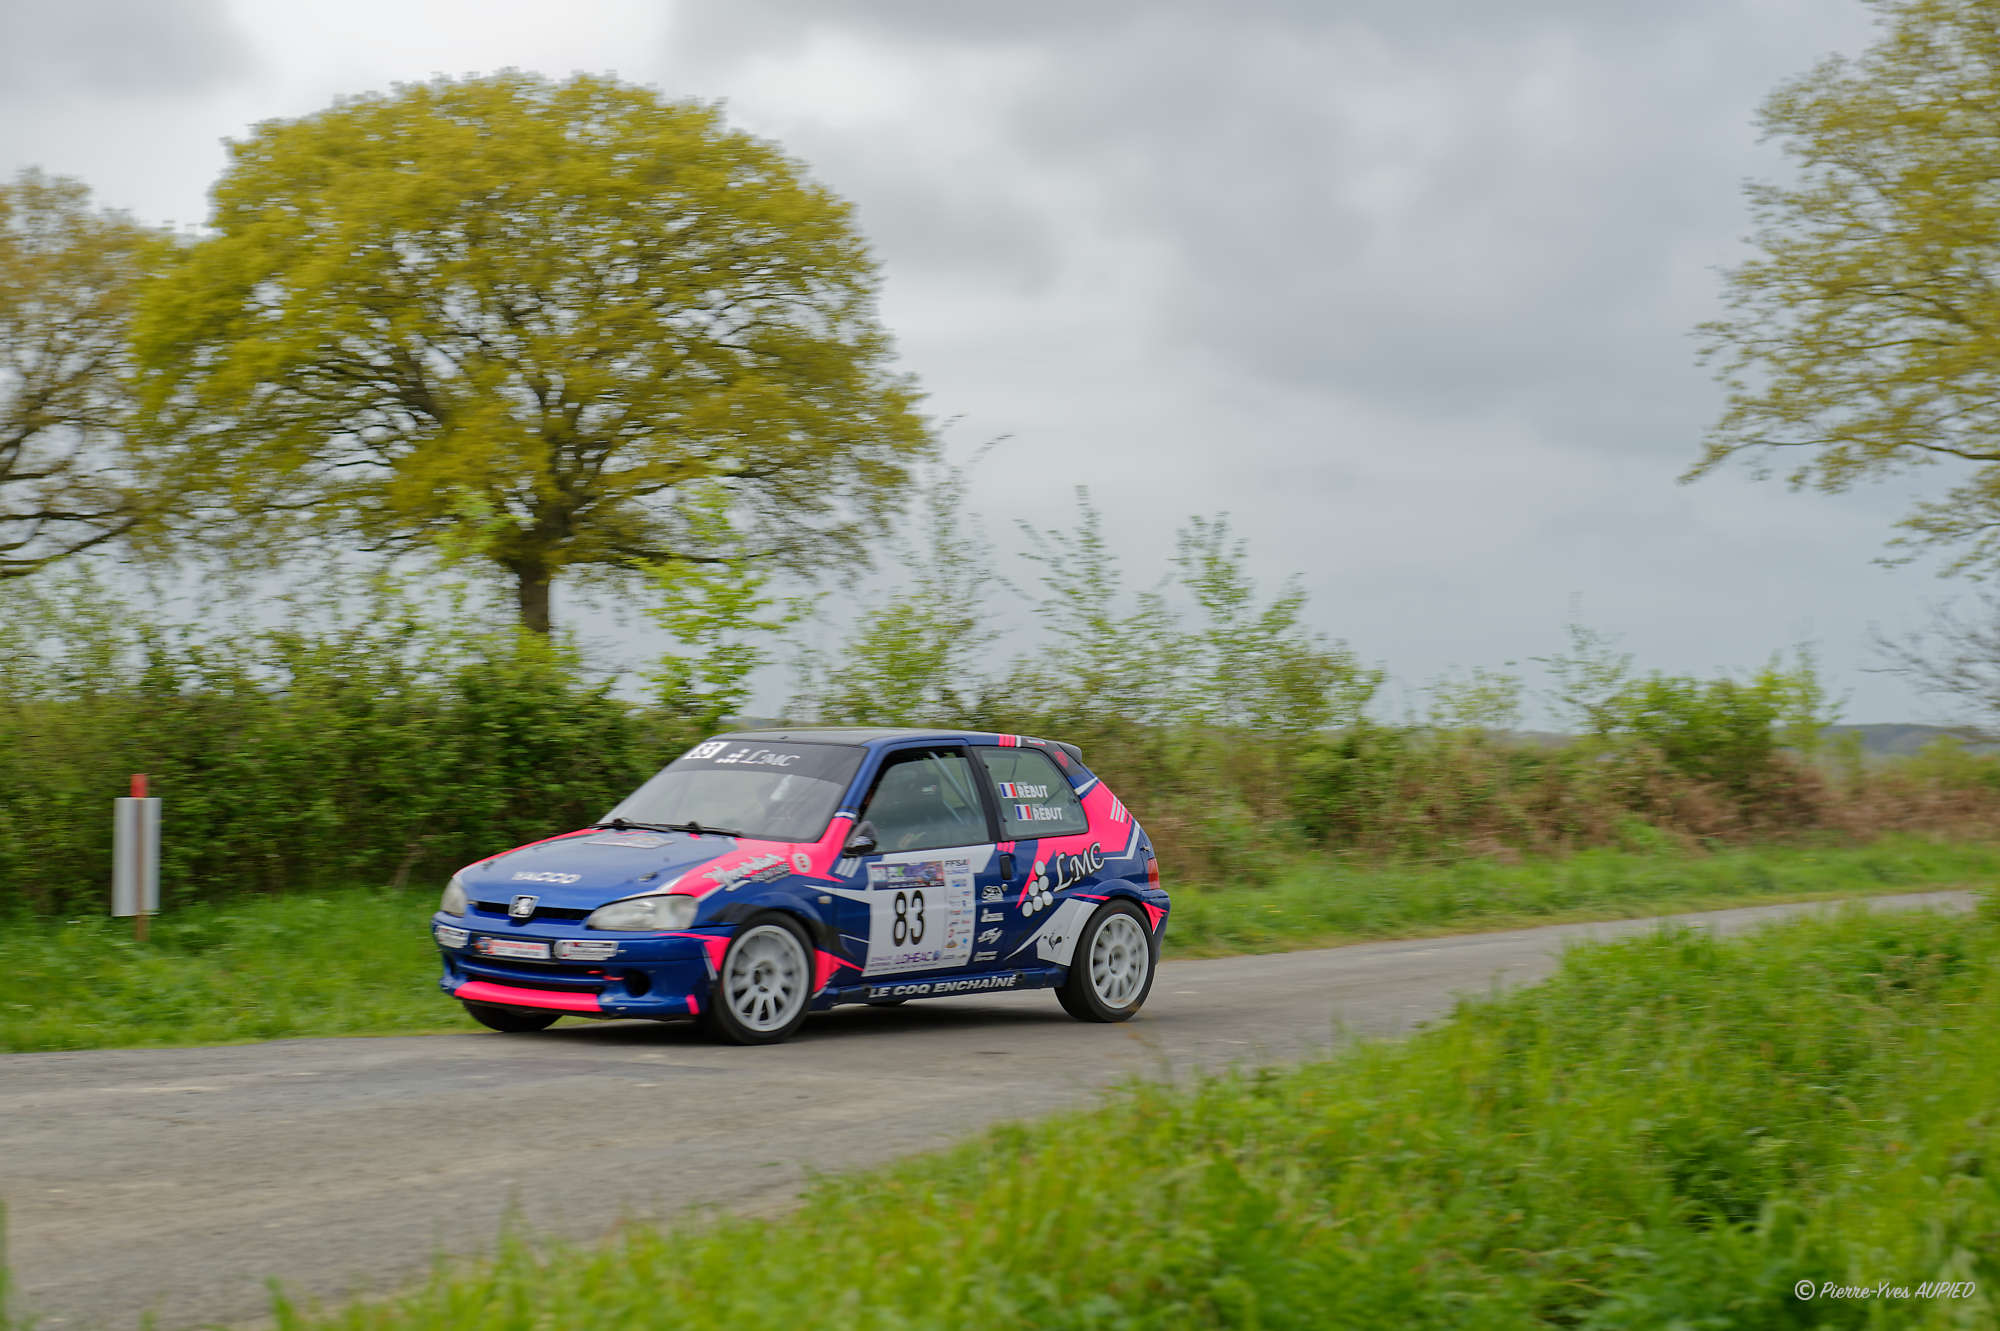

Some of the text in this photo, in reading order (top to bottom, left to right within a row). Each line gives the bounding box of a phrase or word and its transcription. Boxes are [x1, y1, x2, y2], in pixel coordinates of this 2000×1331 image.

[1052, 841, 1105, 893] LMC
[893, 889, 925, 947] 83
[868, 974, 1017, 998] LE COQ ENCHAÎNÉ
